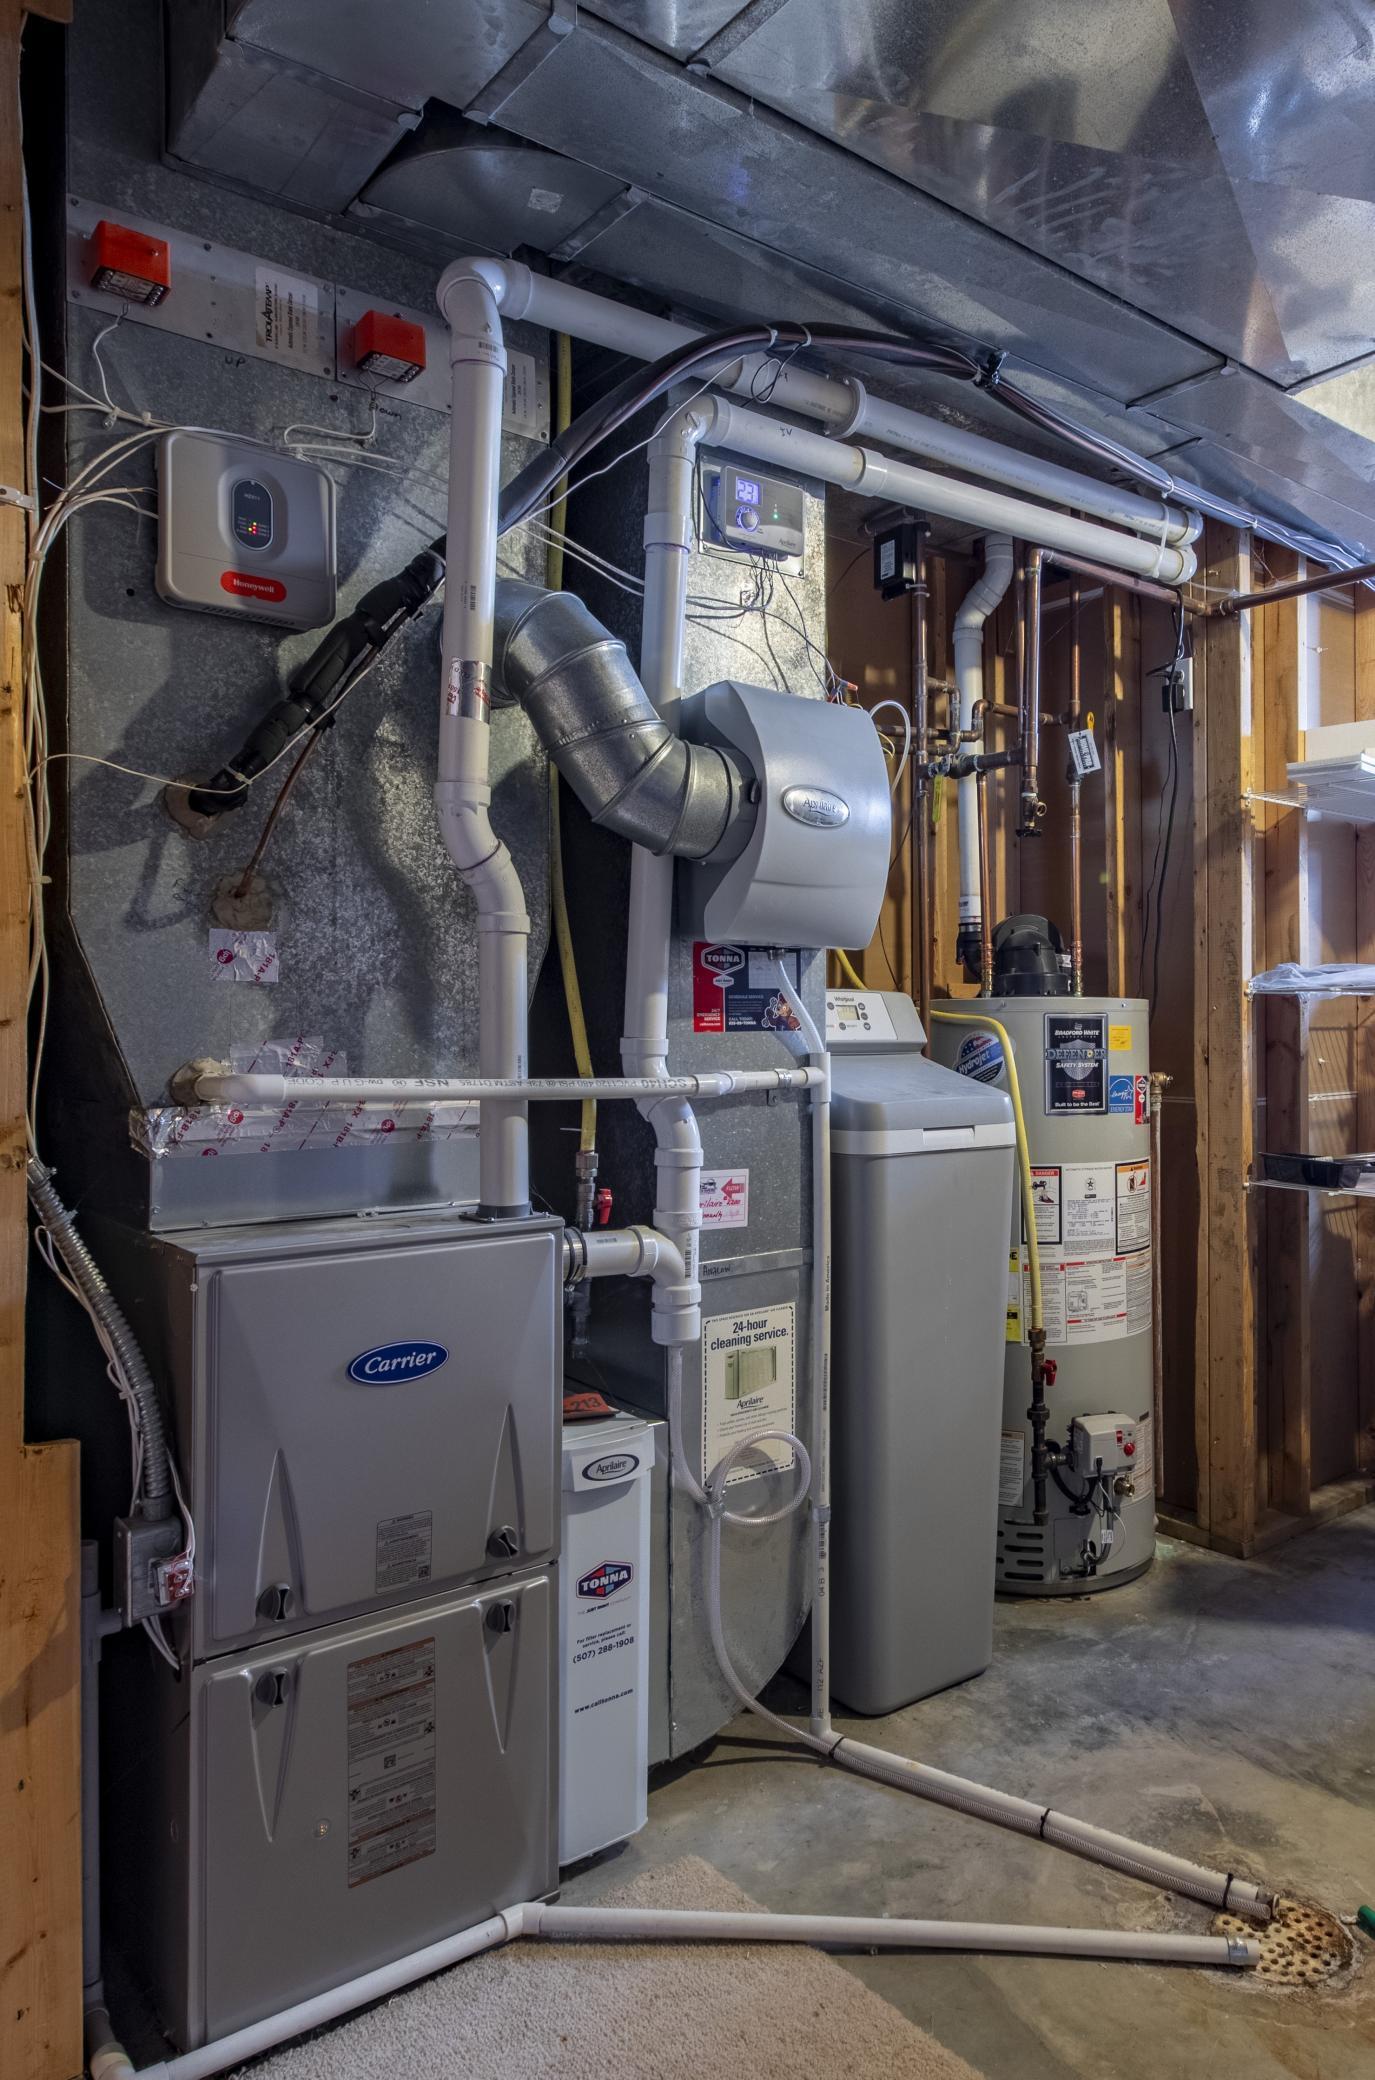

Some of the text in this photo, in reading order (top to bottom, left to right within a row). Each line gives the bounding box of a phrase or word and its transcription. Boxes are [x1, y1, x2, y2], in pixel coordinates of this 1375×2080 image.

[737, 480, 755, 503] 23
[233, 578, 275, 593] Honeywell
[706, 954, 740, 963] TONNA
[958, 1049, 991, 1075] Hydrojet
[1046, 1049, 1106, 1060] DEFENDER
[415, 1079, 450, 1087] NSF
[641, 1078, 687, 1089] SCH40
[732, 1319, 768, 1334] 24-hour
[710, 1327, 789, 1351] cleaning service.
[364, 1351, 437, 1374] Carrier
[737, 1397, 764, 1409] Aprilaire
[596, 1460, 627, 1475] Aprilaire
[581, 1570, 629, 1591] TONNA
[598, 1625, 626, 1637] replacement
[573, 1636, 635, 1664] (507) 288-1908
[574, 1688, 634, 1714] www.calltonna.com
